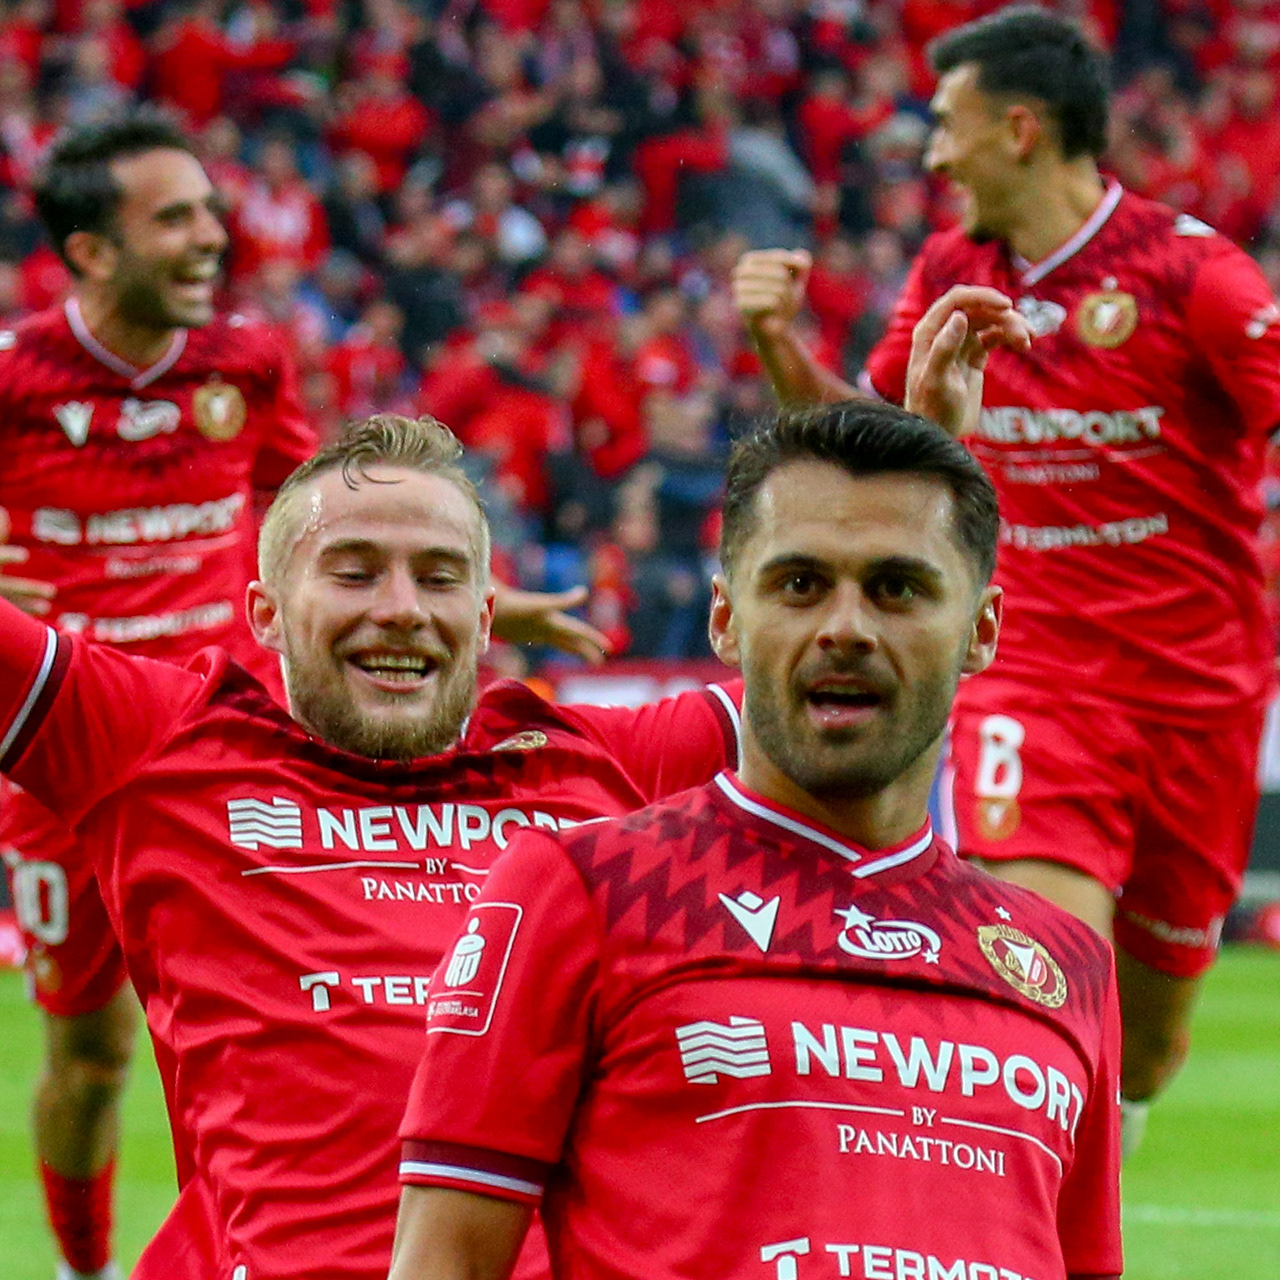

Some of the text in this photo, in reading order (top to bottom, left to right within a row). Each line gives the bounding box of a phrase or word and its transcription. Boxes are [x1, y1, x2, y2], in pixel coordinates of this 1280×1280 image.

[974, 714, 1025, 800] 8
[316, 802, 582, 851] NEWPO
[425, 857, 448, 875] BY
[360, 877, 486, 904] PANATTO
[854, 928, 922, 953] LOTTO
[791, 1020, 1085, 1148] NEWPORT
[911, 1106, 937, 1127] BY
[837, 1124, 1007, 1177] PANATTONI
